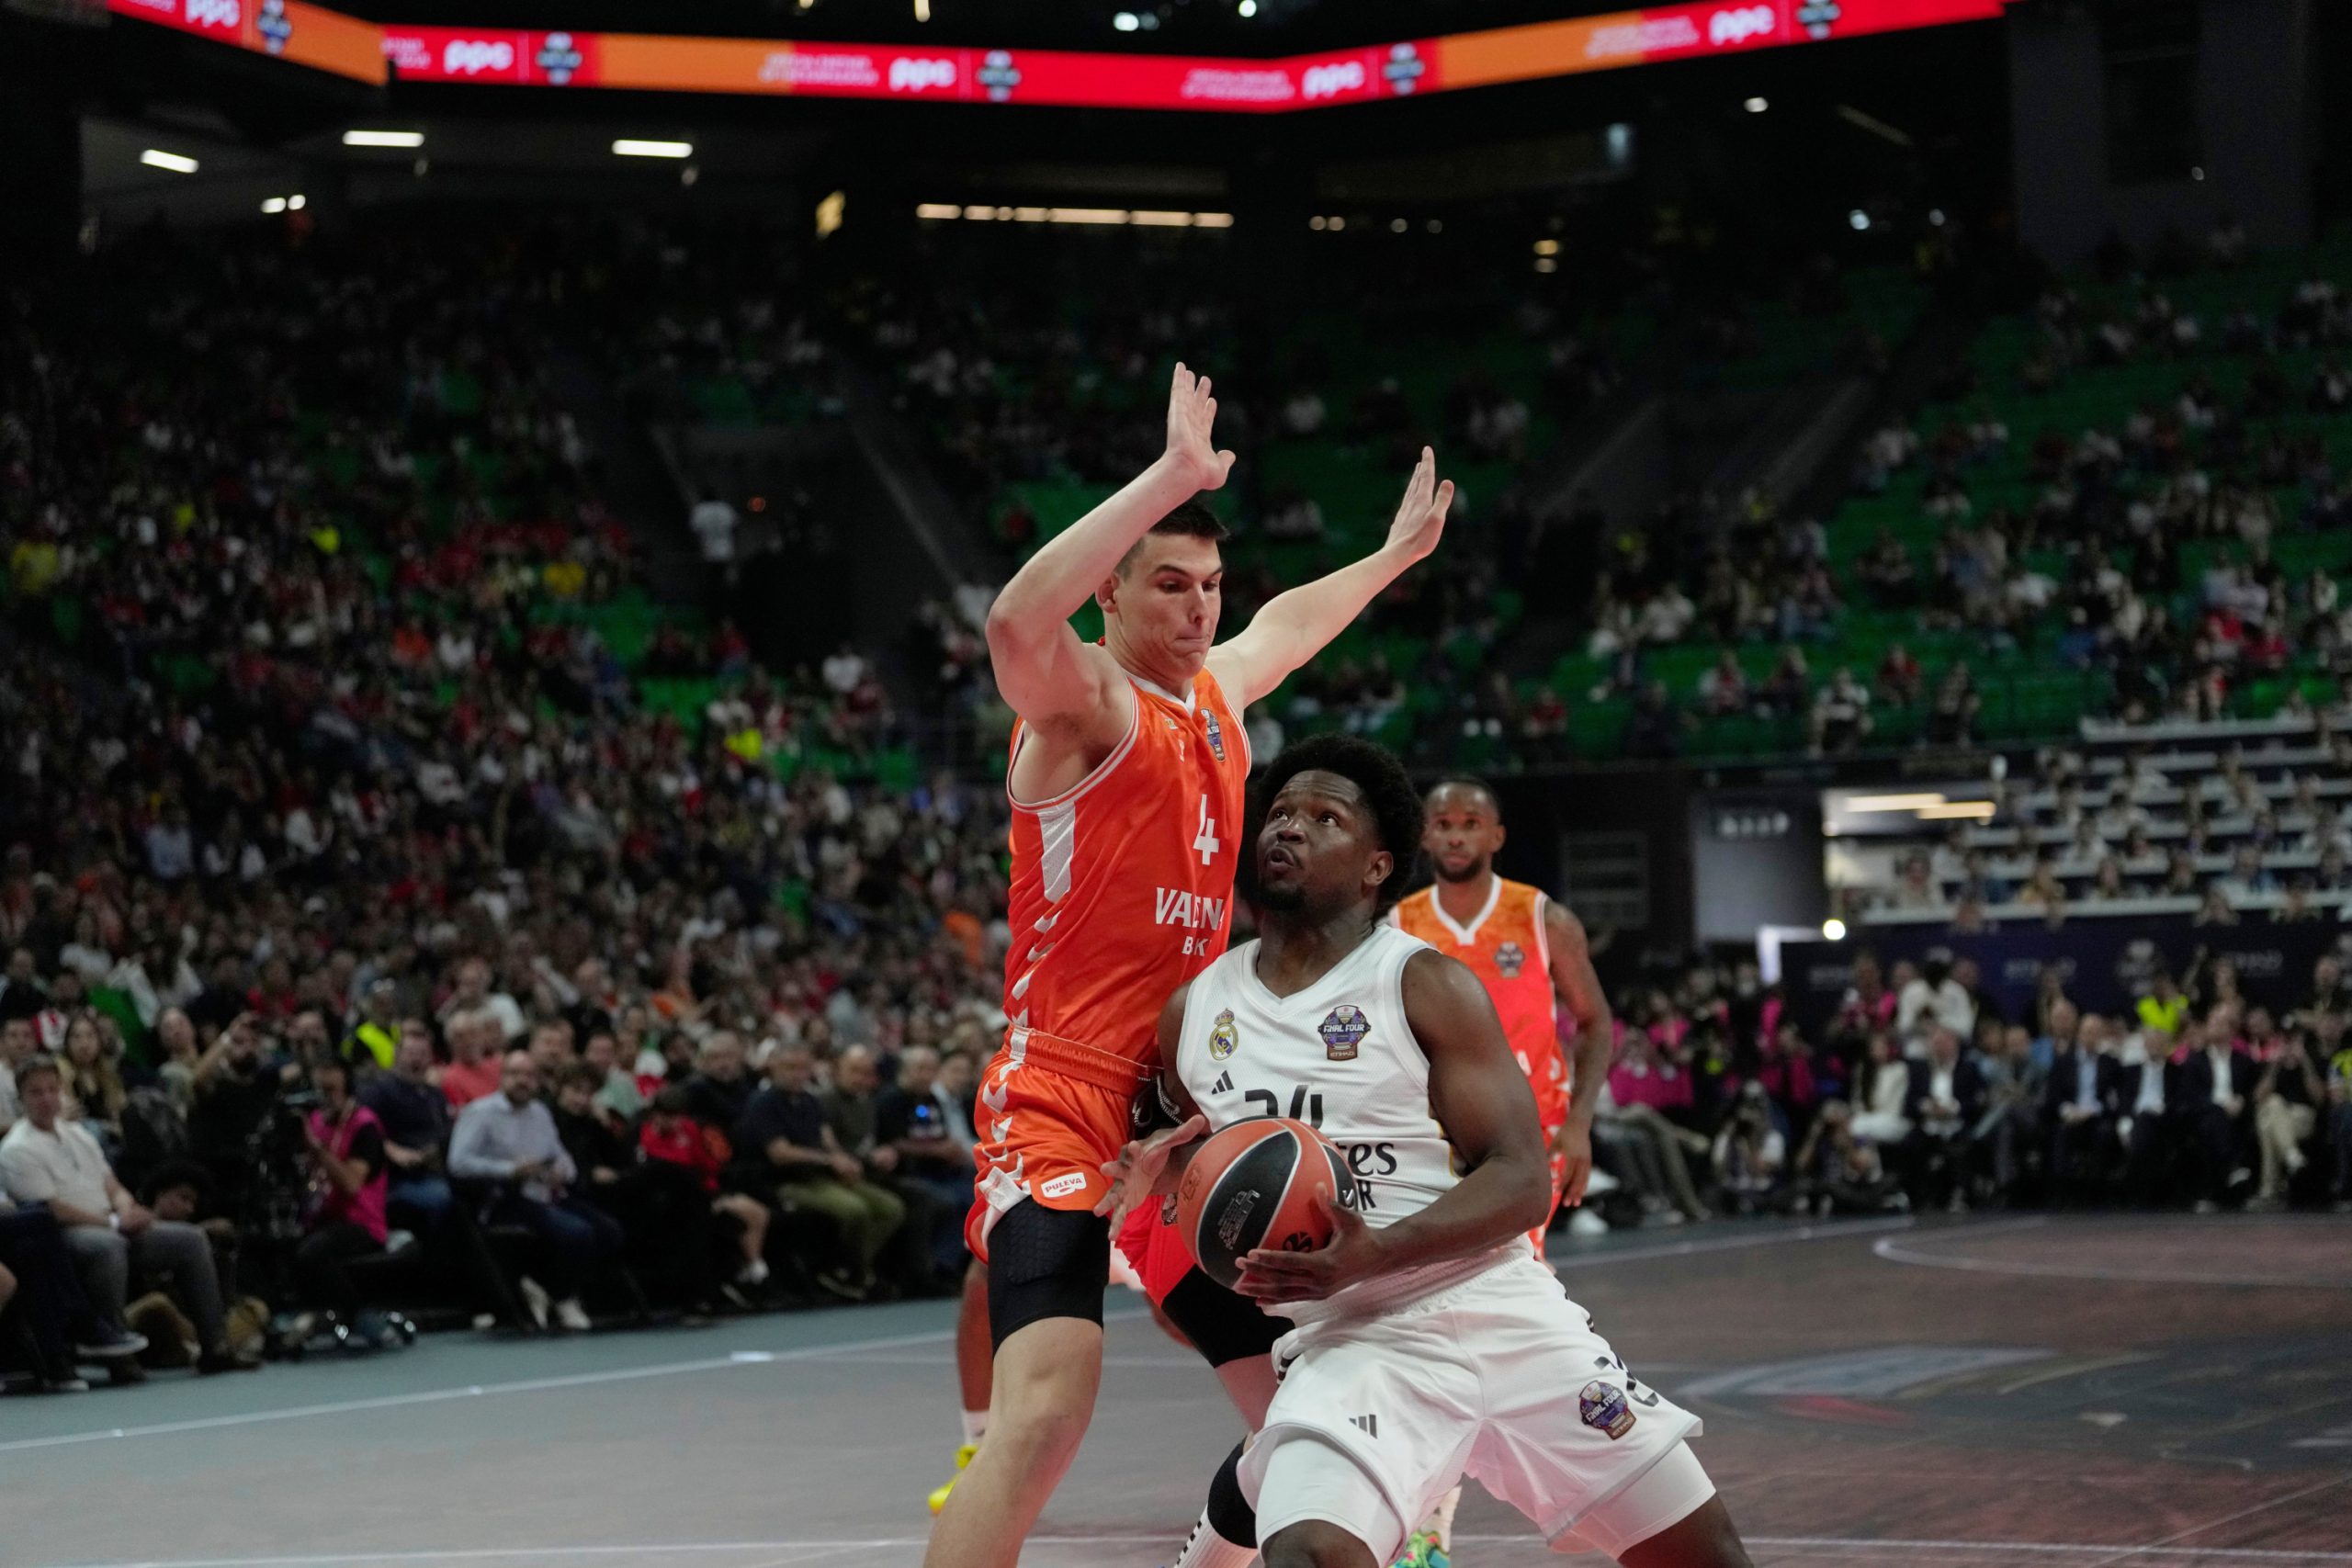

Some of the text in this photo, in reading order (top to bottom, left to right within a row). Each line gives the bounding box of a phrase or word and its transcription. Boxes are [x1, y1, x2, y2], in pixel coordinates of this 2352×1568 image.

[1193, 794, 1220, 865] 4
[1323, 1023, 1365, 1032] FINAL FOUR
[1045, 1178, 1082, 1192] PULEVA
[1585, 1404, 1607, 1423] FINAL
[1602, 1389, 1621, 1407] FOUR
